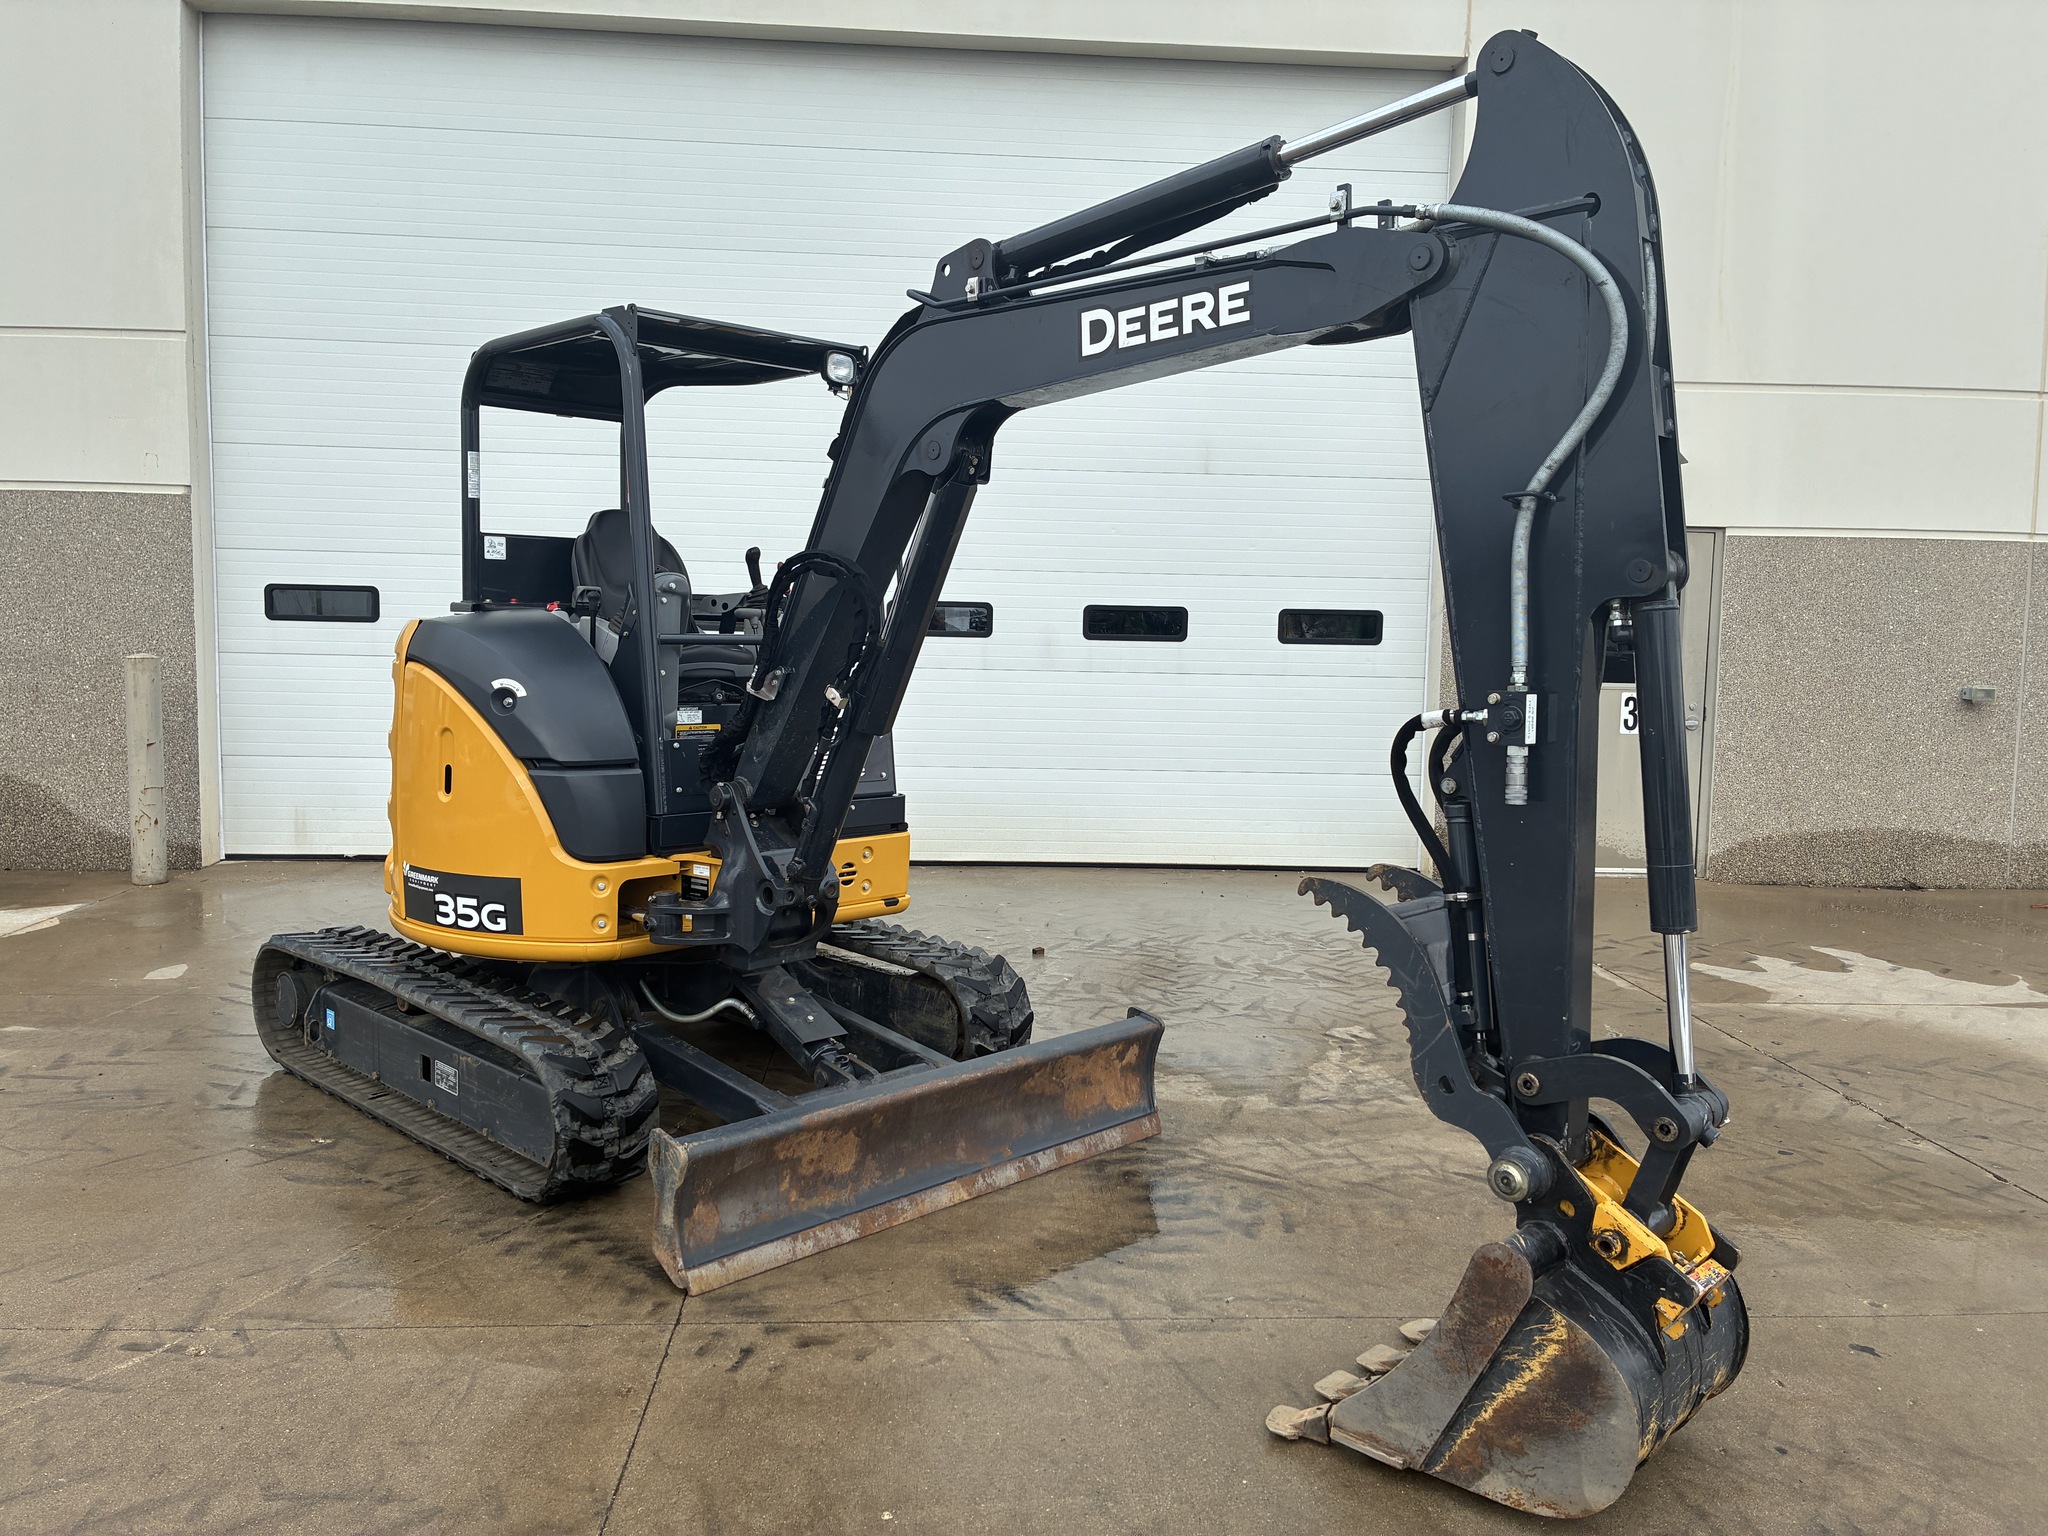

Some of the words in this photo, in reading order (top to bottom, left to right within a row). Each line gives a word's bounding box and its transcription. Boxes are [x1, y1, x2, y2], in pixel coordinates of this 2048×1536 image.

[1081, 281, 1250, 357] DEERE
[1623, 697, 1638, 731] 3
[407, 870, 439, 884] GREENMARK
[434, 893, 507, 932] 35G
